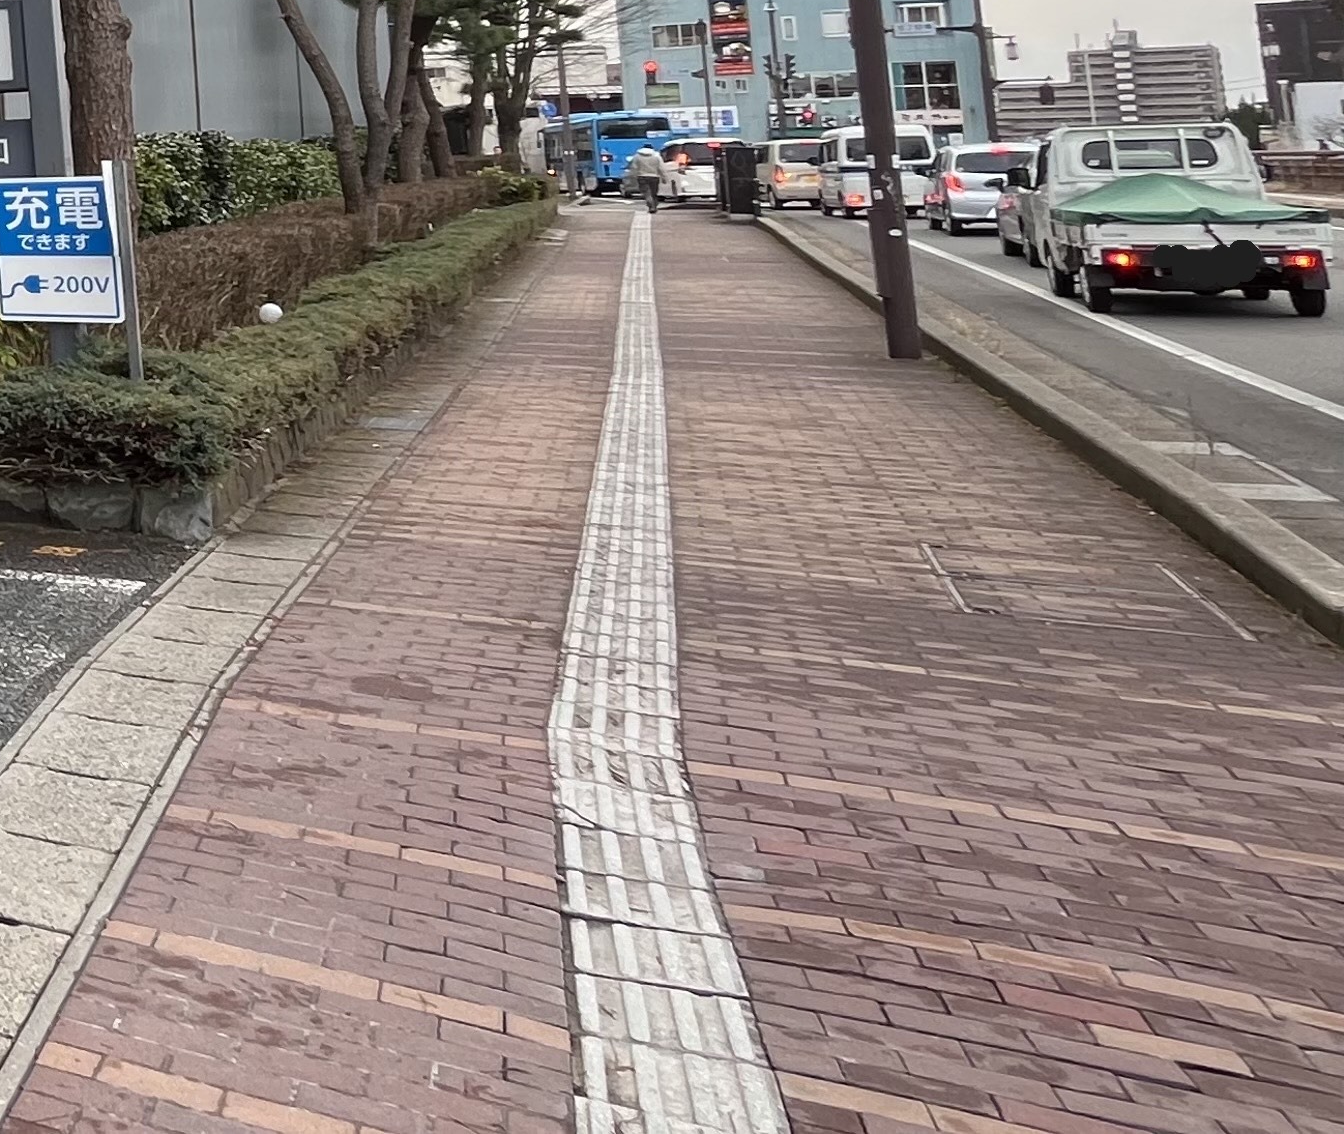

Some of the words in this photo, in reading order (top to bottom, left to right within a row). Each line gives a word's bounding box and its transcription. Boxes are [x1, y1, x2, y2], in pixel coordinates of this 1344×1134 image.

[3, 185, 104, 231] 充電
[17, 233, 90, 252] できます
[53, 275, 110, 294] 200V
